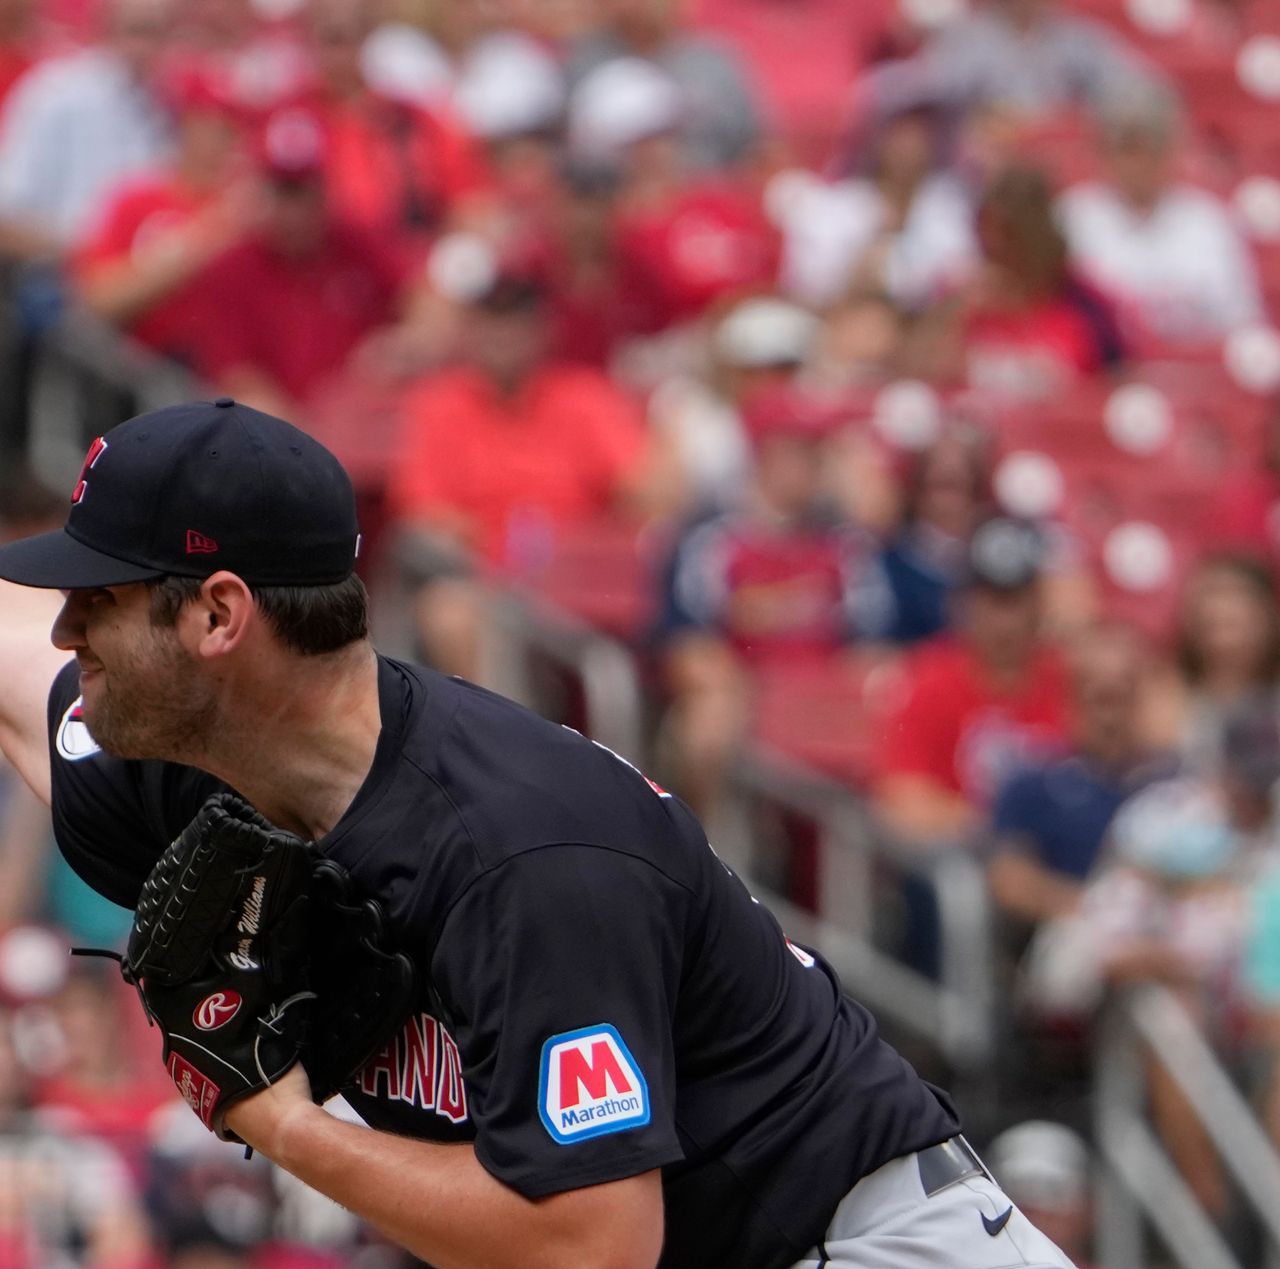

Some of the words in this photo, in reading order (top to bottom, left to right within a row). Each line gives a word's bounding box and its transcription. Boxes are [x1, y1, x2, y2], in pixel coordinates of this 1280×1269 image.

[237, 876, 267, 934] Williams
[198, 992, 237, 1029] R
[355, 1012, 468, 1124] AND
[559, 1040, 633, 1110] M
[560, 1096, 640, 1129] Marathon
